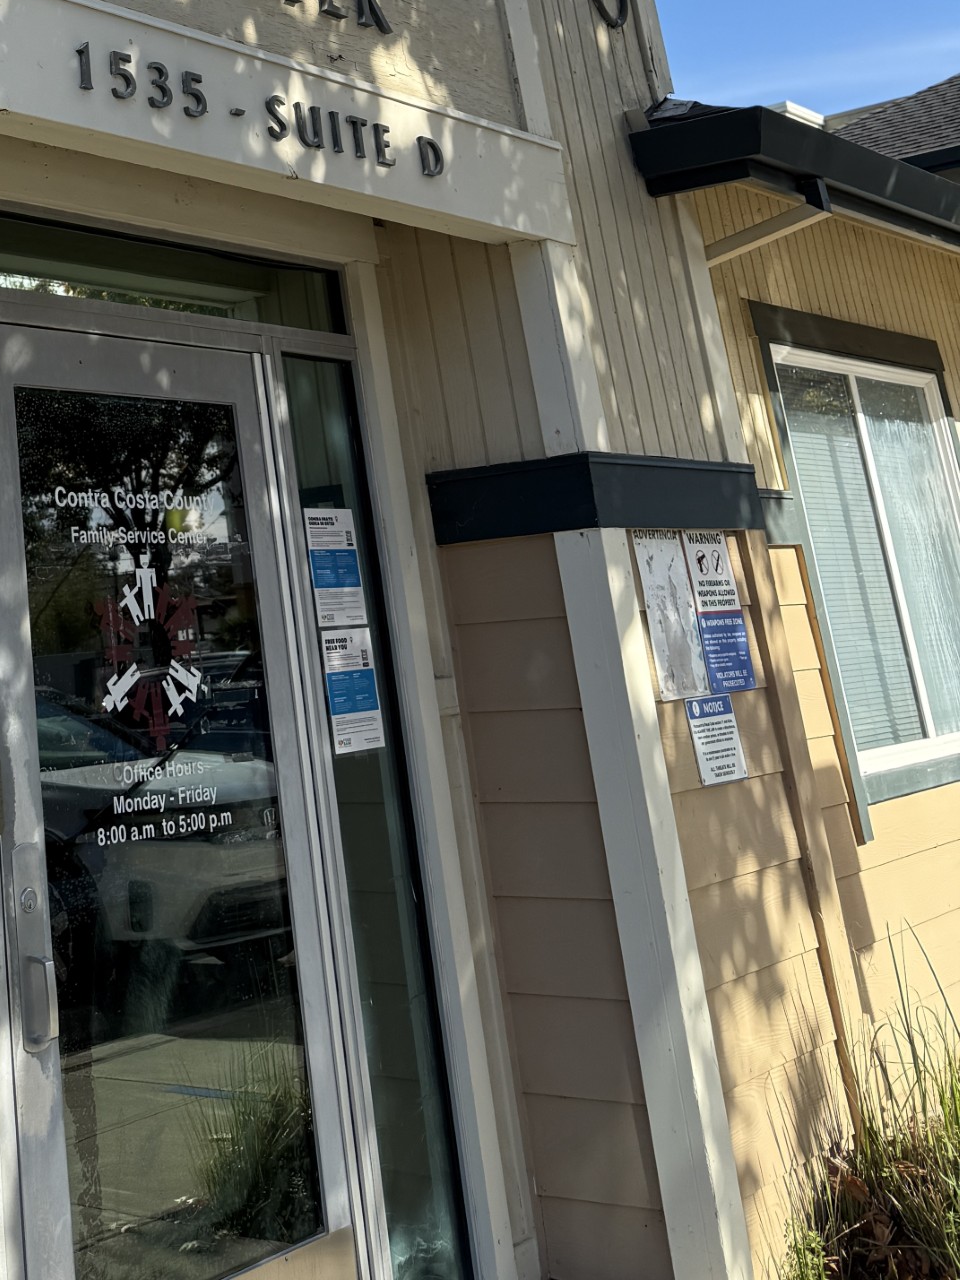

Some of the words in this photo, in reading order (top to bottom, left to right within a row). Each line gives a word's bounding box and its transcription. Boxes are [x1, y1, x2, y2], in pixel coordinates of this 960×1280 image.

[76, 41, 208, 118] 1535
[266, 94, 396, 167] SUITE
[416, 136, 444, 177] D
[54, 486, 110, 508] Contra
[114, 488, 159, 510] Costa
[163, 490, 214, 513] County
[70, 526, 114, 547] Family
[118, 526, 166, 544] Service
[168, 527, 208, 544] Center
[686, 531, 722, 544] WARNING
[702, 701, 724, 714] NOTICE
[123, 764, 163, 784] Office
[165, 761, 204, 778] Hours
[113, 791, 166, 814] Monday
[178, 785, 217, 805] Friday
[97, 824, 127, 846] 8:00
[130, 823, 155, 841] a.m
[162, 818, 176, 836] to
[179, 812, 206, 833] 5:00
[209, 811, 232, 832] p.m
